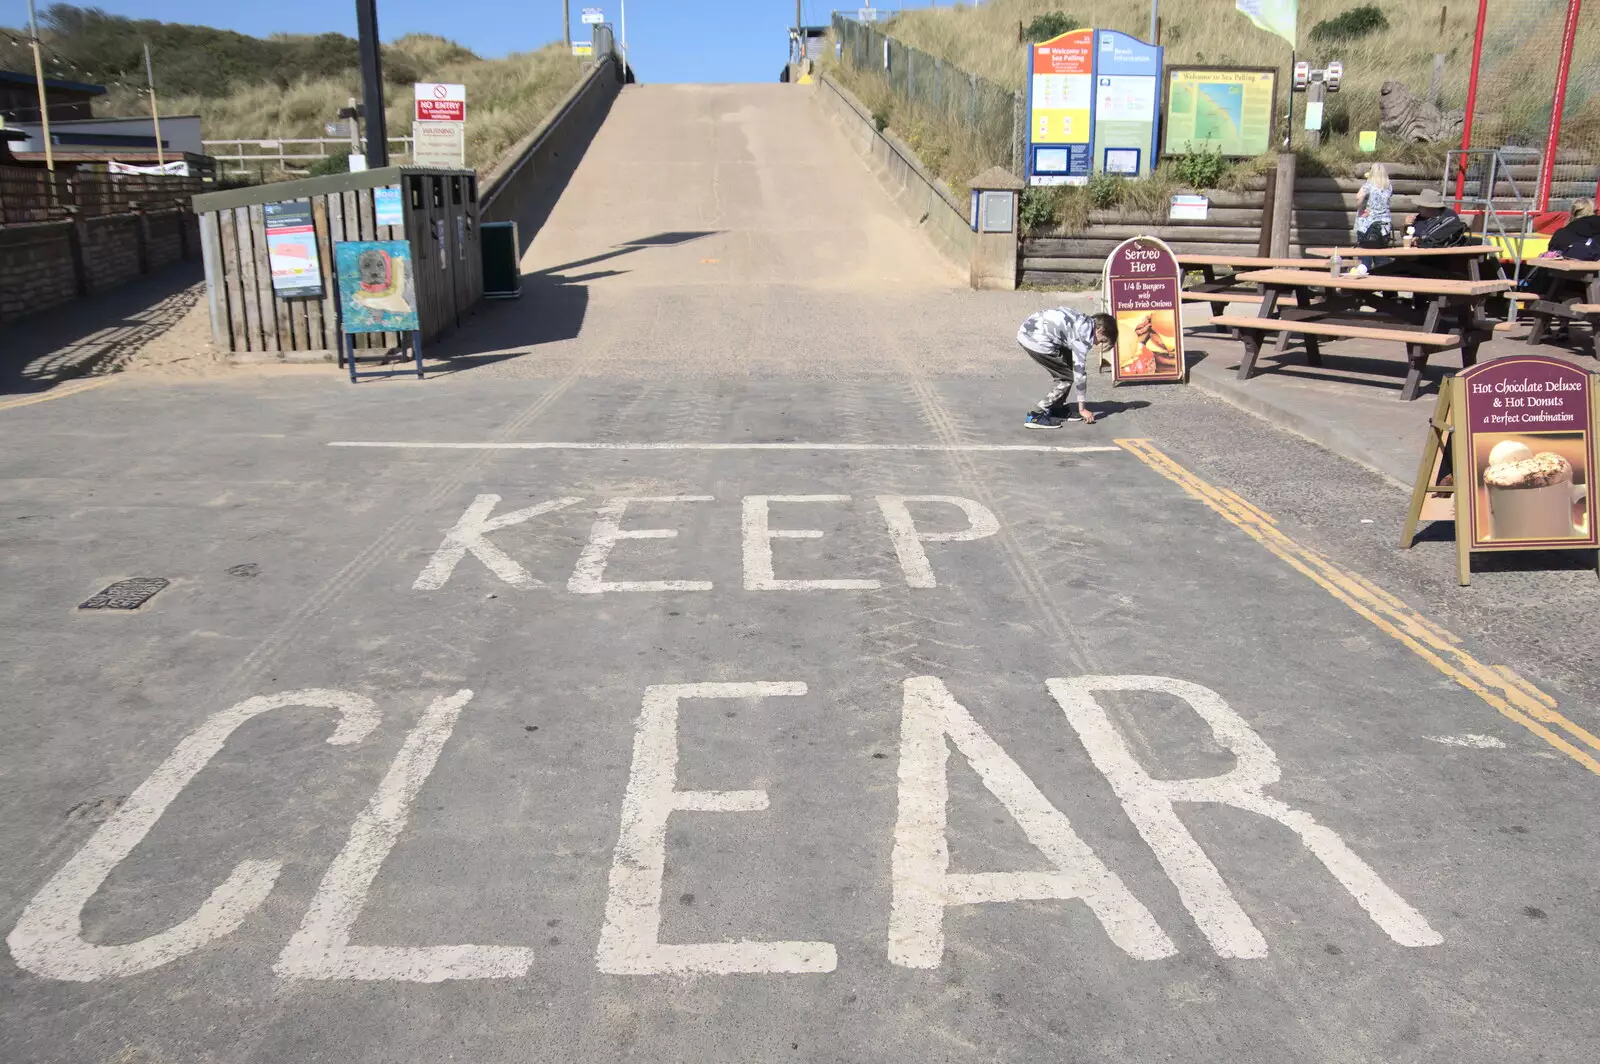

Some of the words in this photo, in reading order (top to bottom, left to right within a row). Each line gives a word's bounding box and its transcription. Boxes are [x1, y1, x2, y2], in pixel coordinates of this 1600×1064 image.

[434, 102, 460, 110] ENTRY
[1125, 248, 1160, 260] Served
[1130, 262, 1156, 272] Here
[1124, 282, 1135, 291] 1/4
[1142, 283, 1166, 291] Burgers
[1138, 291, 1150, 300] with
[1118, 299, 1134, 309] Fresh
[1134, 300, 1150, 308] Fried
[1150, 300, 1172, 308] Onions
[1472, 383, 1492, 394] Hot
[1494, 378, 1542, 394] Chocolate
[1545, 377, 1582, 392] Deluxe
[1492, 397, 1502, 408] &
[1505, 397, 1524, 408] Hot
[1527, 396, 1564, 407] Donuts
[1491, 411, 1520, 426] Perfect
[1522, 410, 1574, 423] Combination
[411, 493, 1000, 593] KEEP
[6, 674, 1444, 983] CLEAR
